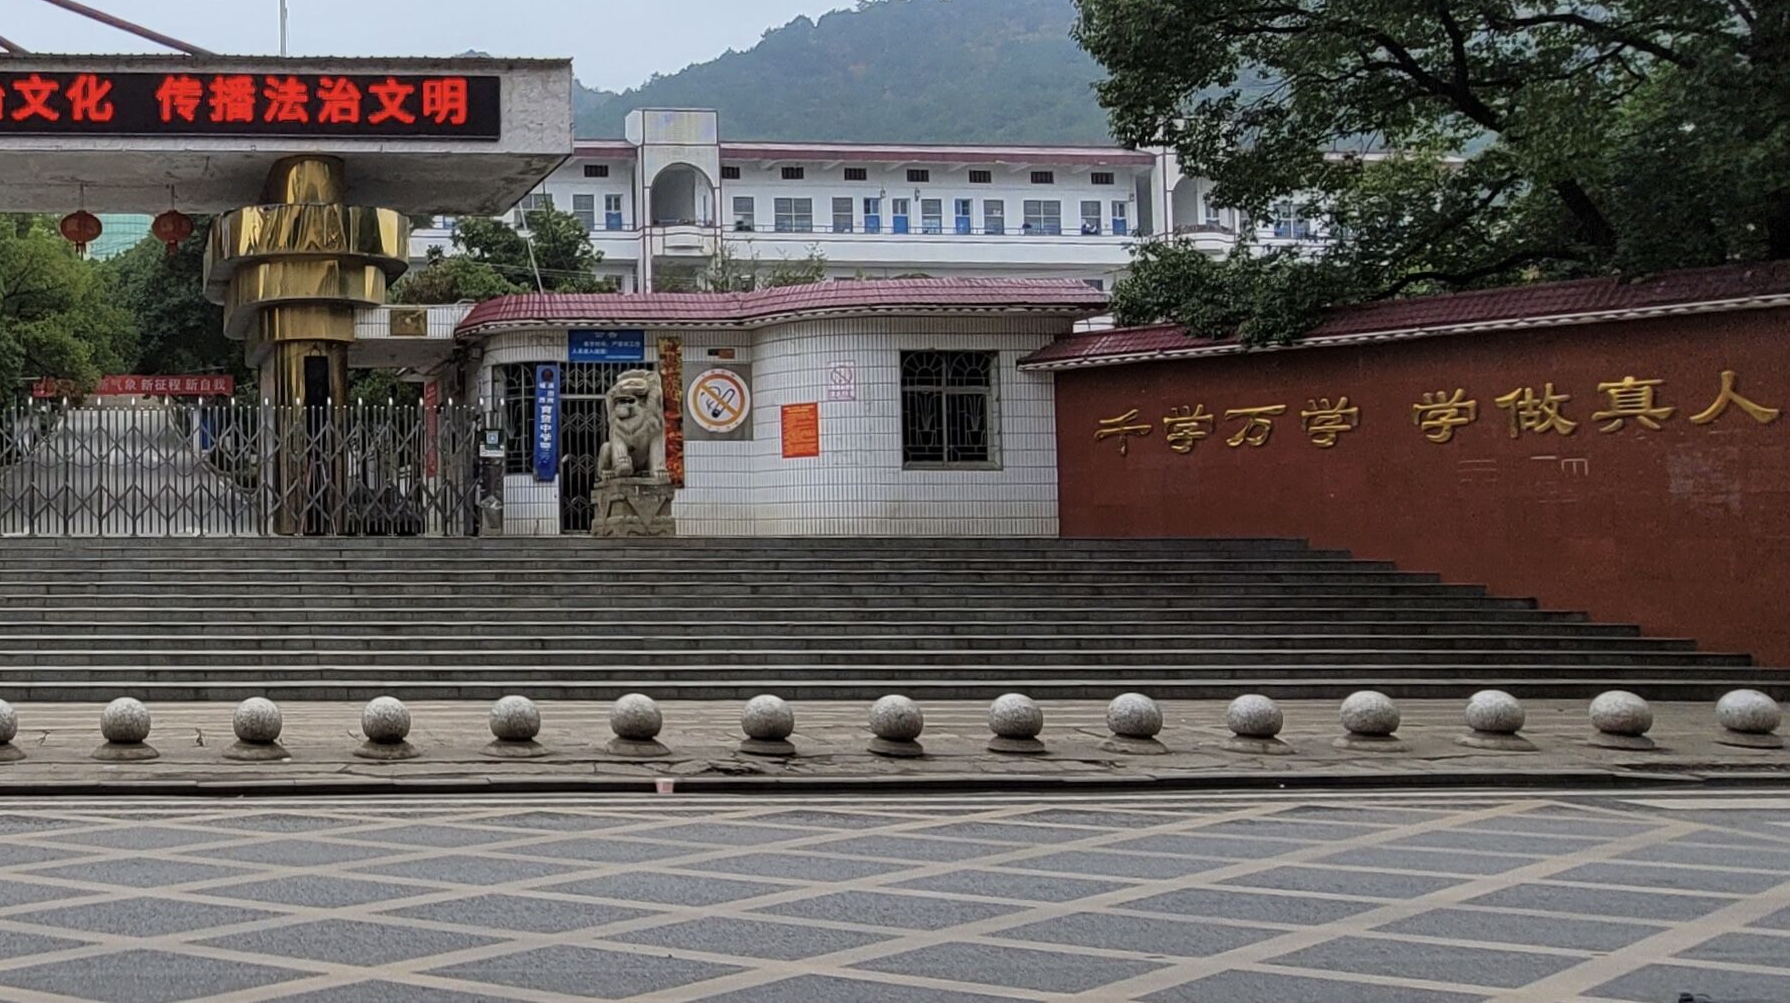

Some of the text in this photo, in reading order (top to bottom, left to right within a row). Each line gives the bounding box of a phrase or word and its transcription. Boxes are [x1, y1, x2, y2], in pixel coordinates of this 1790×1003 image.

[156, 75, 468, 125] 传播法治文明
[141, 378, 181, 391] 新征程
[185, 378, 227, 392] 新自我
[1096, 369, 1780, 454] 千学万学 学做真人
